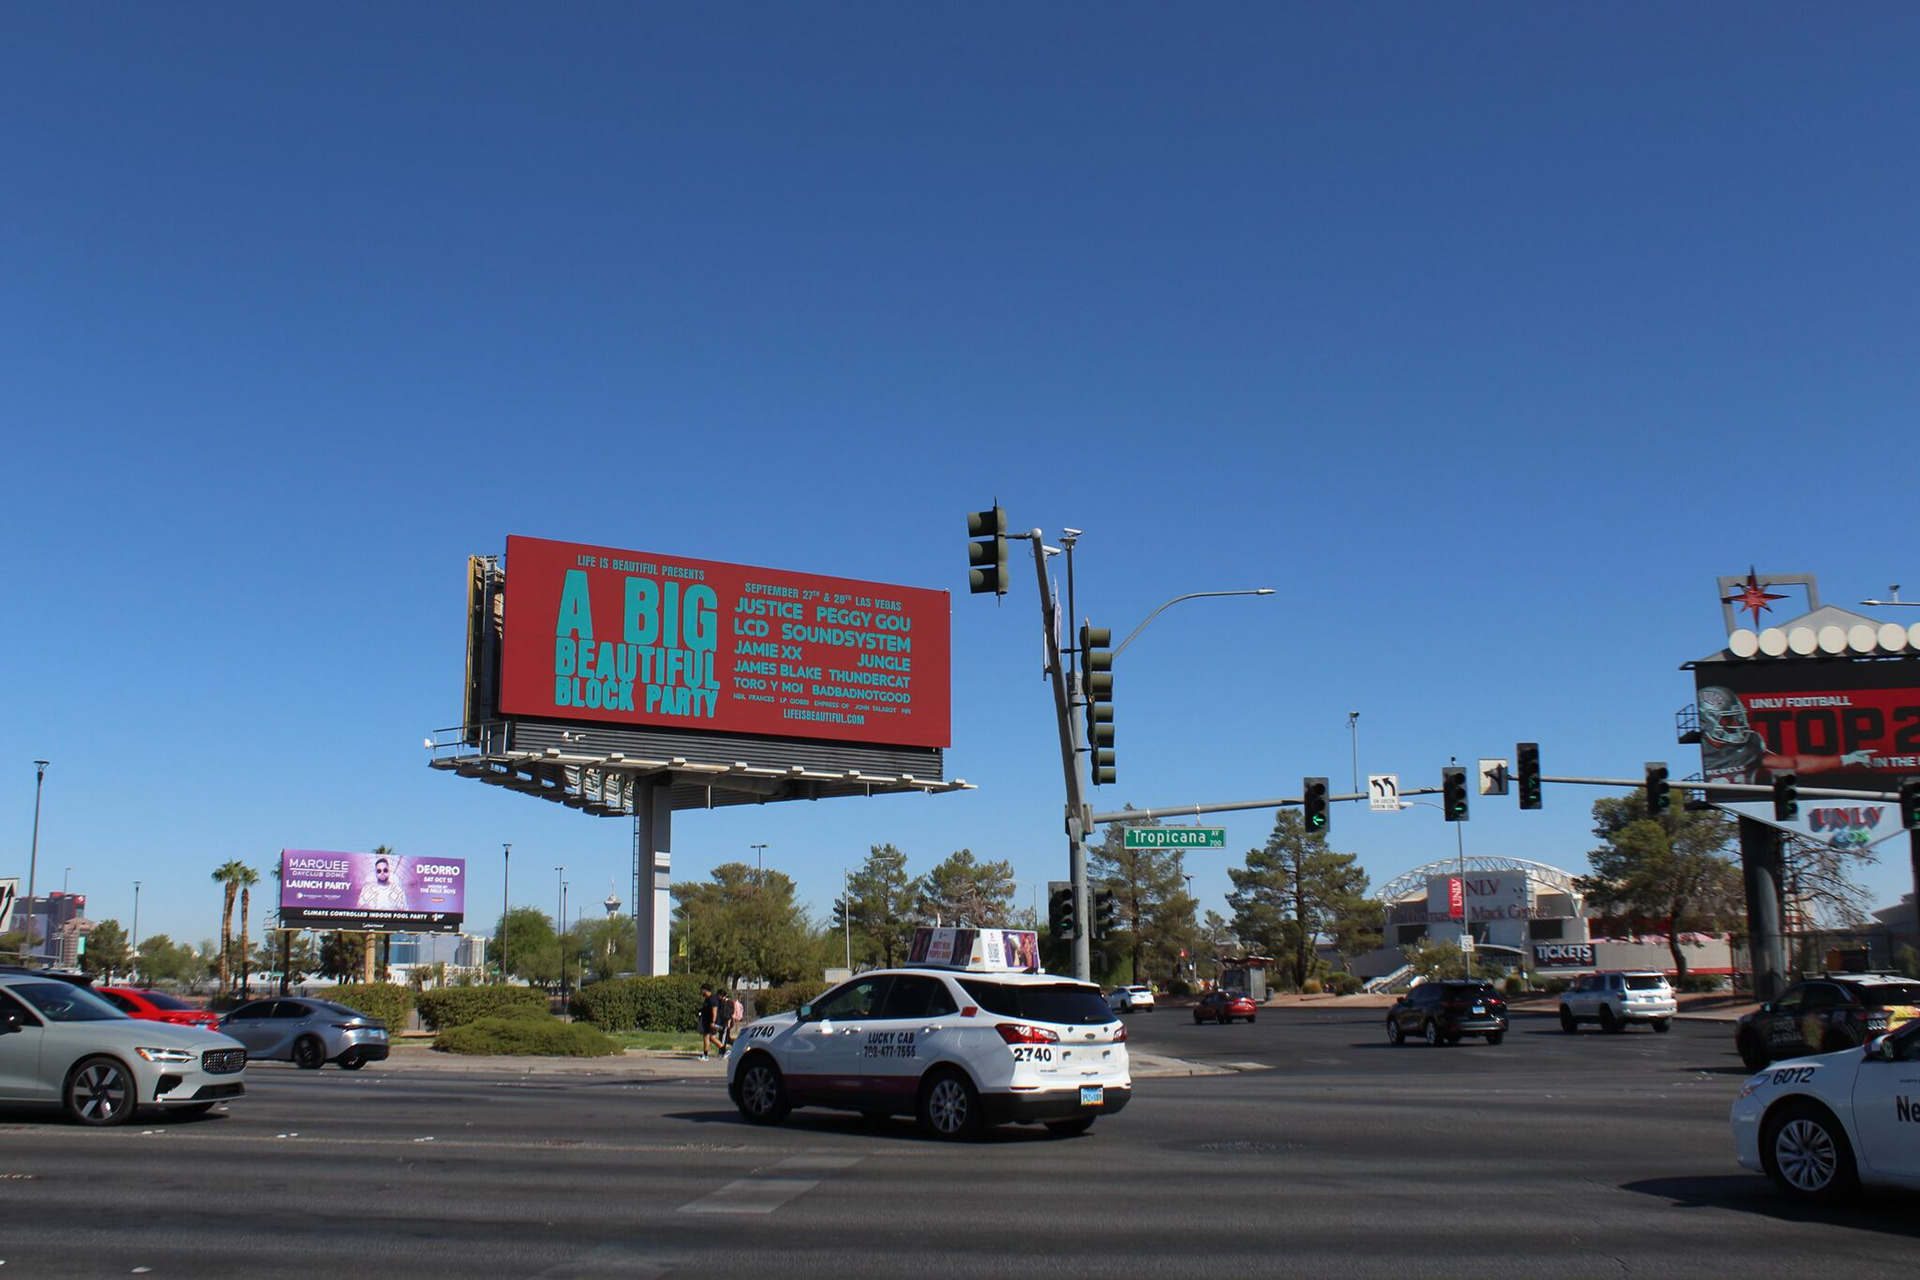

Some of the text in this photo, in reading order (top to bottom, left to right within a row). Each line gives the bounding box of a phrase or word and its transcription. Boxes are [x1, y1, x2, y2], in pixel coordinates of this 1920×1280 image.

[577, 555, 704, 580] LIFE IS BEAUTIFUL PRESENTS
[745, 582, 799, 598] SEPTEMBER
[824, 593, 830, 602] &
[855, 597, 873, 607] LAS
[874, 598, 902, 611] VEGAS
[556, 569, 718, 652] A BIG
[734, 597, 911, 632] JUSTICE PEGGY GOU
[734, 618, 911, 653] LCD SOUNDSYSTEM
[555, 637, 720, 690] BEAUTIFUL
[734, 640, 911, 671] JAMIE XX JUNGLE
[734, 660, 911, 688] JAMES BLAKE THUNDERCAT
[555, 676, 718, 718] BLOCK PARTY
[734, 677, 911, 703] TORO Y MOI BADBADNOTGOOD
[749, 694, 775, 702] FRANCES
[814, 701, 839, 709] EMPRESS
[1750, 696, 1853, 708] UNLV FOOTBALL
[783, 708, 864, 725] LIFEISBEAUTIFUL.COM
[1752, 707, 1884, 755] TOP
[1890, 756, 1916, 767] THE
[1810, 807, 1885, 829] UNLV
[1133, 830, 1206, 846] Tropicana
[289, 858, 350, 870] MARQUEE
[416, 864, 460, 876] DEORRO
[292, 870, 324, 878] DAYCLUB
[286, 879, 352, 890] LAUNCH PARTY
[1453, 879, 1462, 907] UNLV
[329, 910, 368, 918] CONTROLLED
[1471, 905, 1506, 920] Mack
[1536, 944, 1592, 960] TICKETS
[749, 1026, 774, 1038] 2740
[868, 1032, 915, 1044] LUCKY CAB
[864, 1045, 916, 1058] 702-477-7555
[1014, 1047, 1052, 1062] 2740
[1773, 1067, 1815, 1085] 6012
